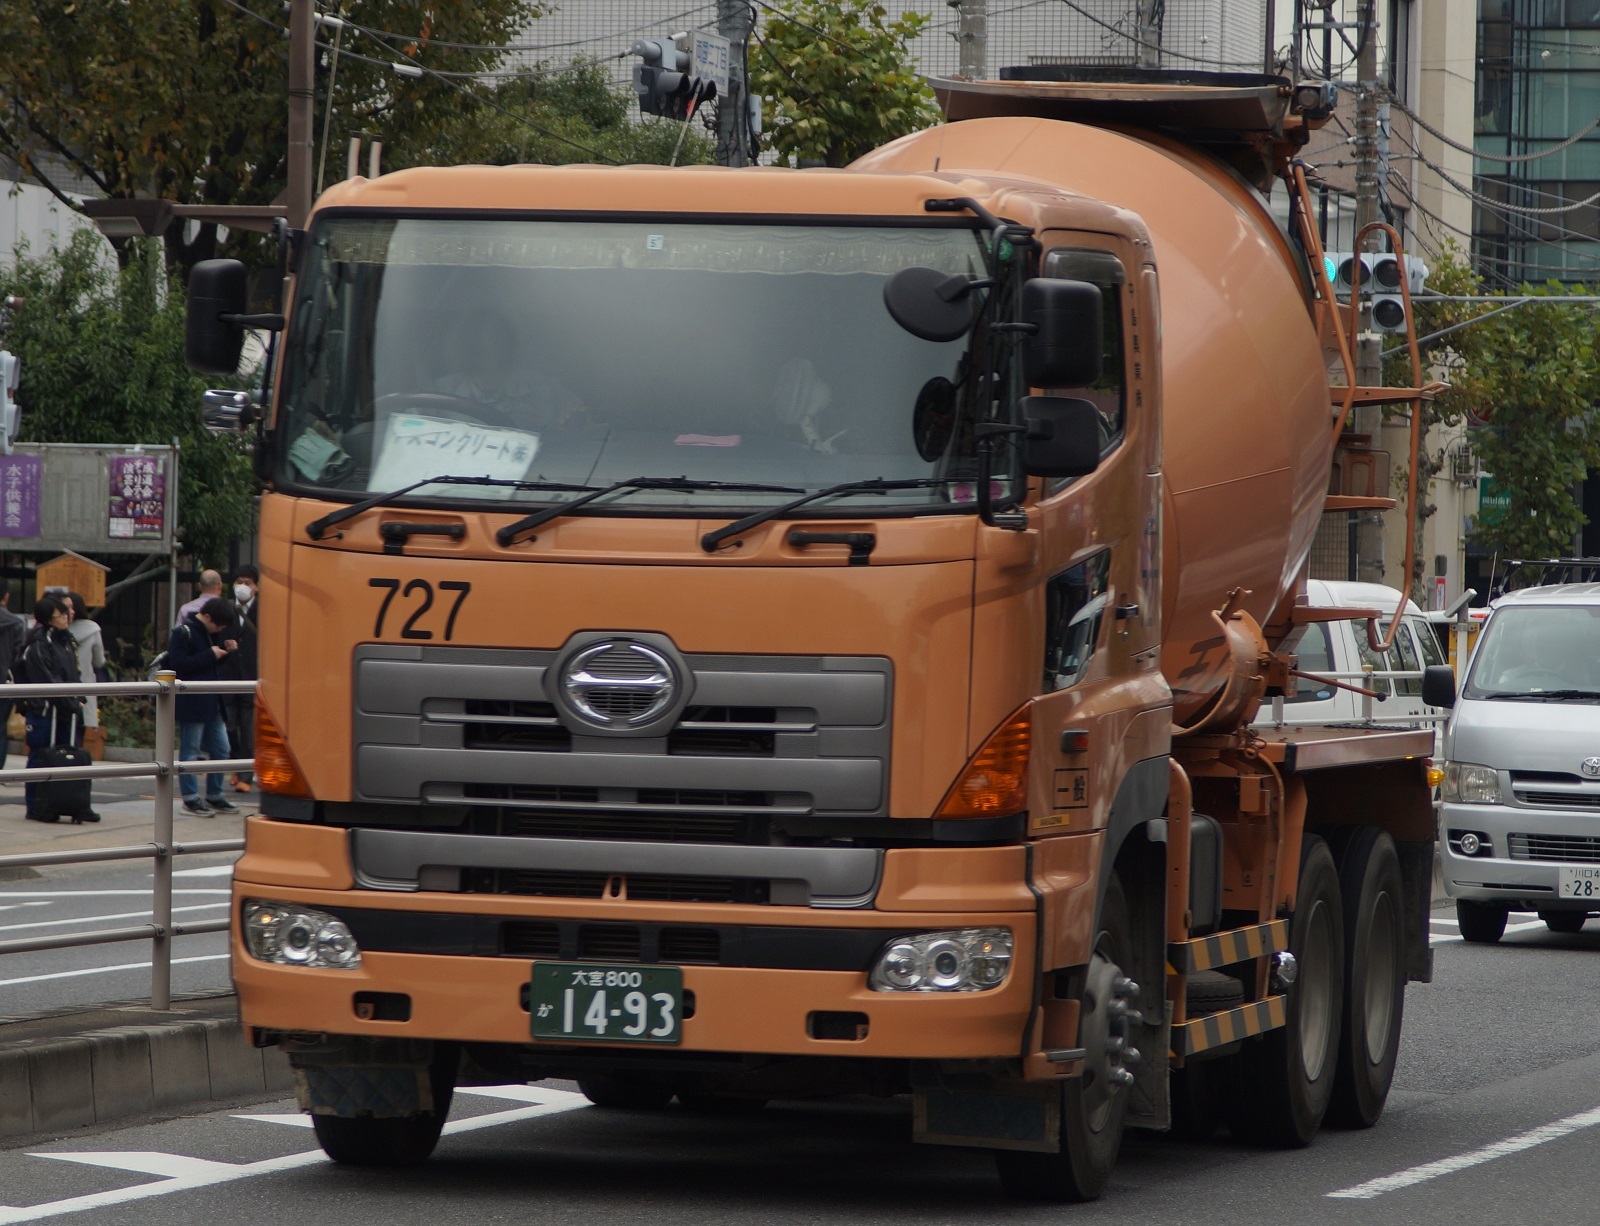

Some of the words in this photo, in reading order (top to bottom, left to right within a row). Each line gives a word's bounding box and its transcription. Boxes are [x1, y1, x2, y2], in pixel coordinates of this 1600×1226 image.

[5, 463, 22, 528] 水子供養会
[368, 578, 471, 641] 727
[563, 988, 675, 1037] 14-93
